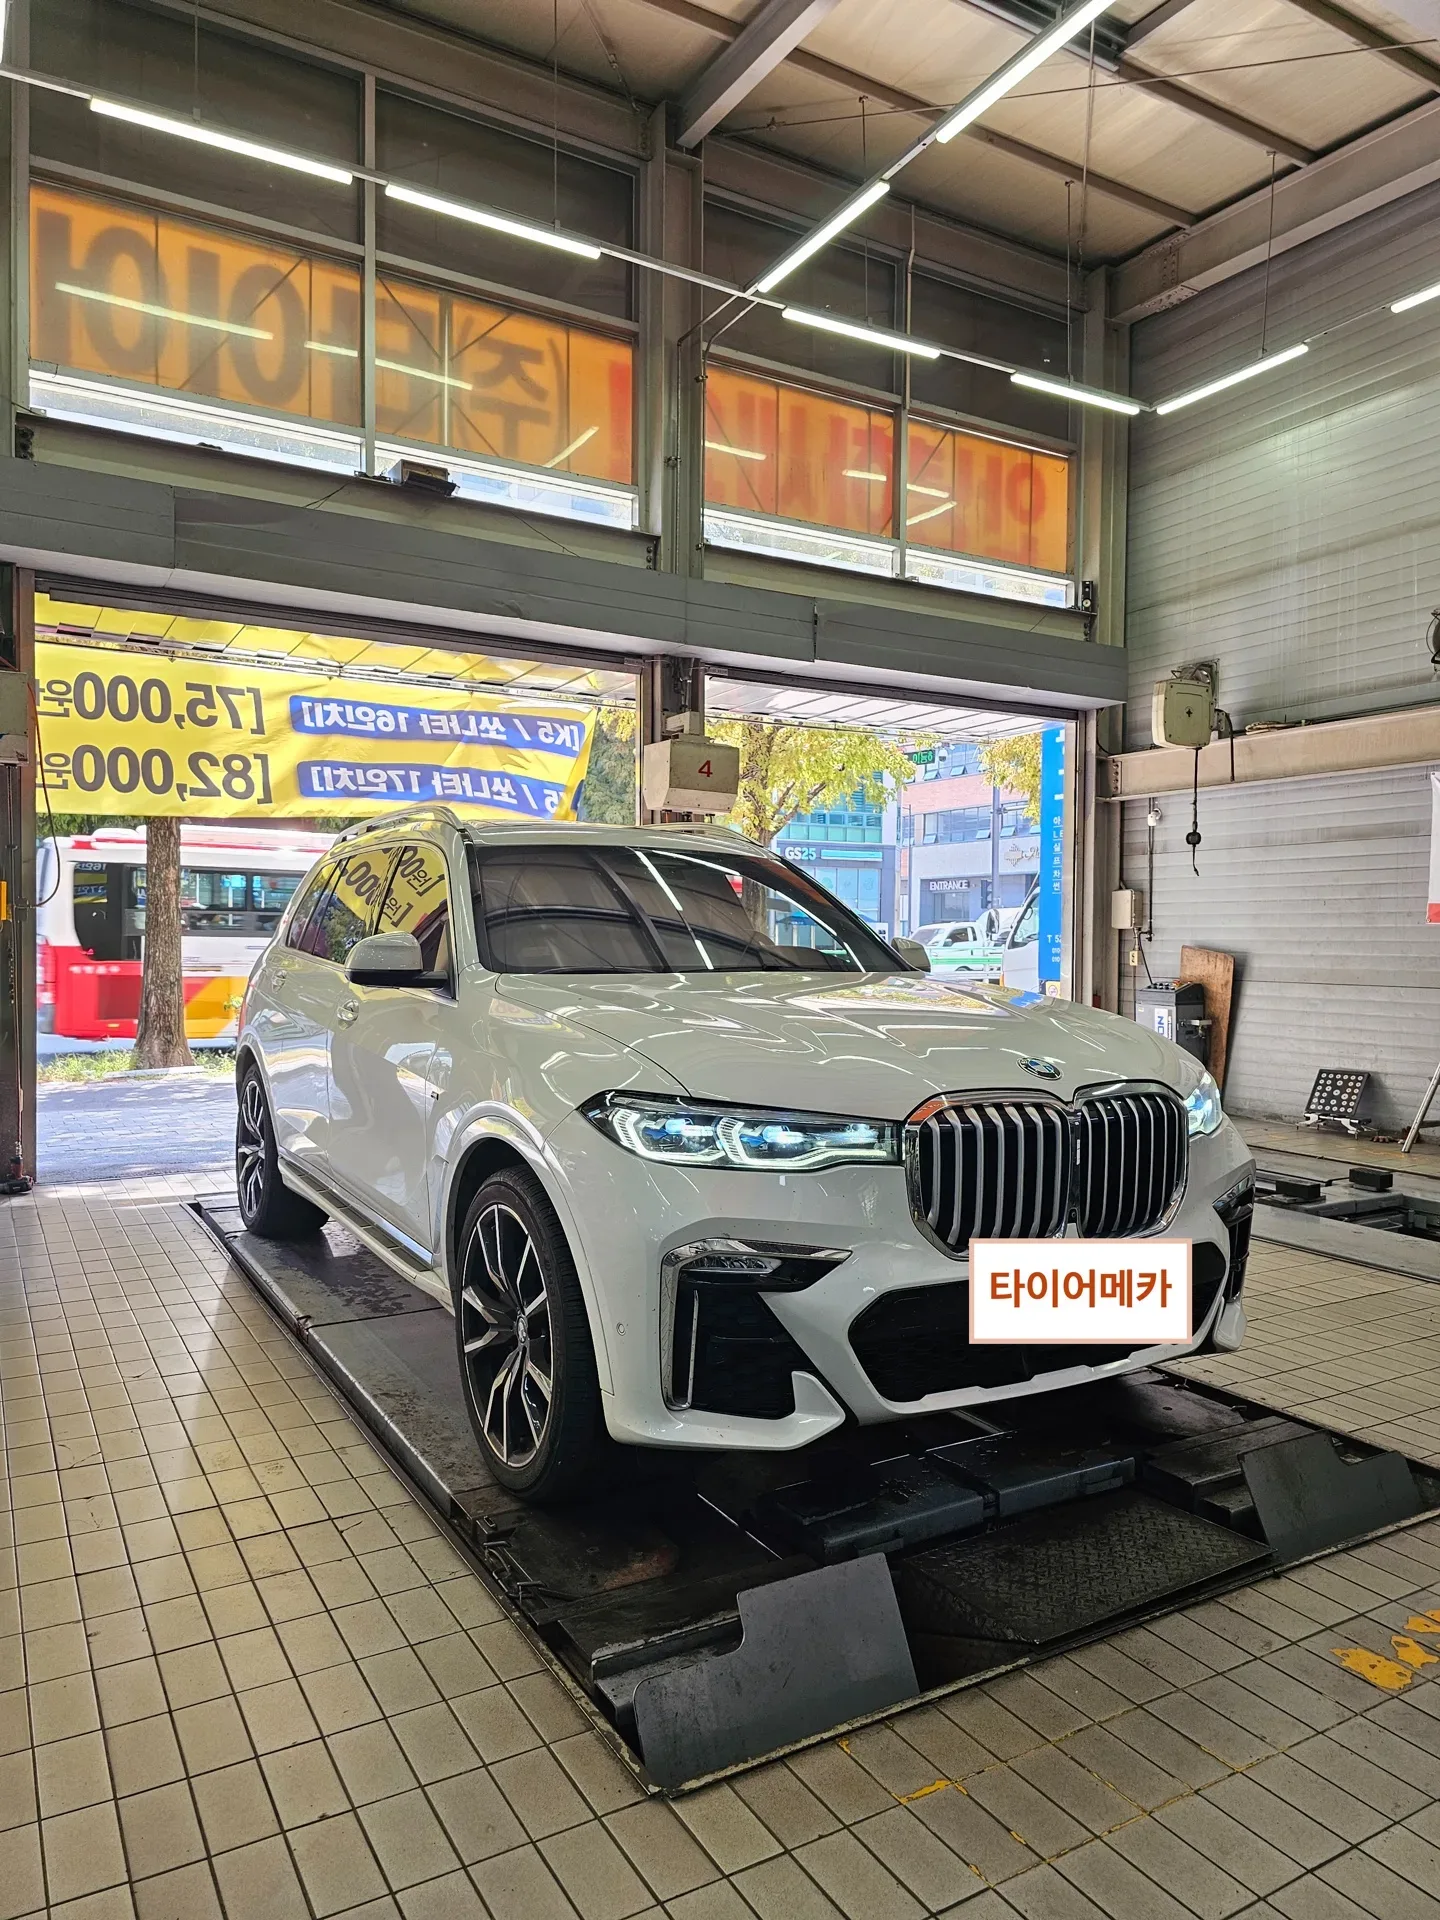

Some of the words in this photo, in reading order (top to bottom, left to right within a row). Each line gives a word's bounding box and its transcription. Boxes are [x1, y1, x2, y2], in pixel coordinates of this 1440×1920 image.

[698, 759, 713, 778] 4
[784, 847, 816, 861] GS25
[929, 880, 969, 891] ENTRANCE
